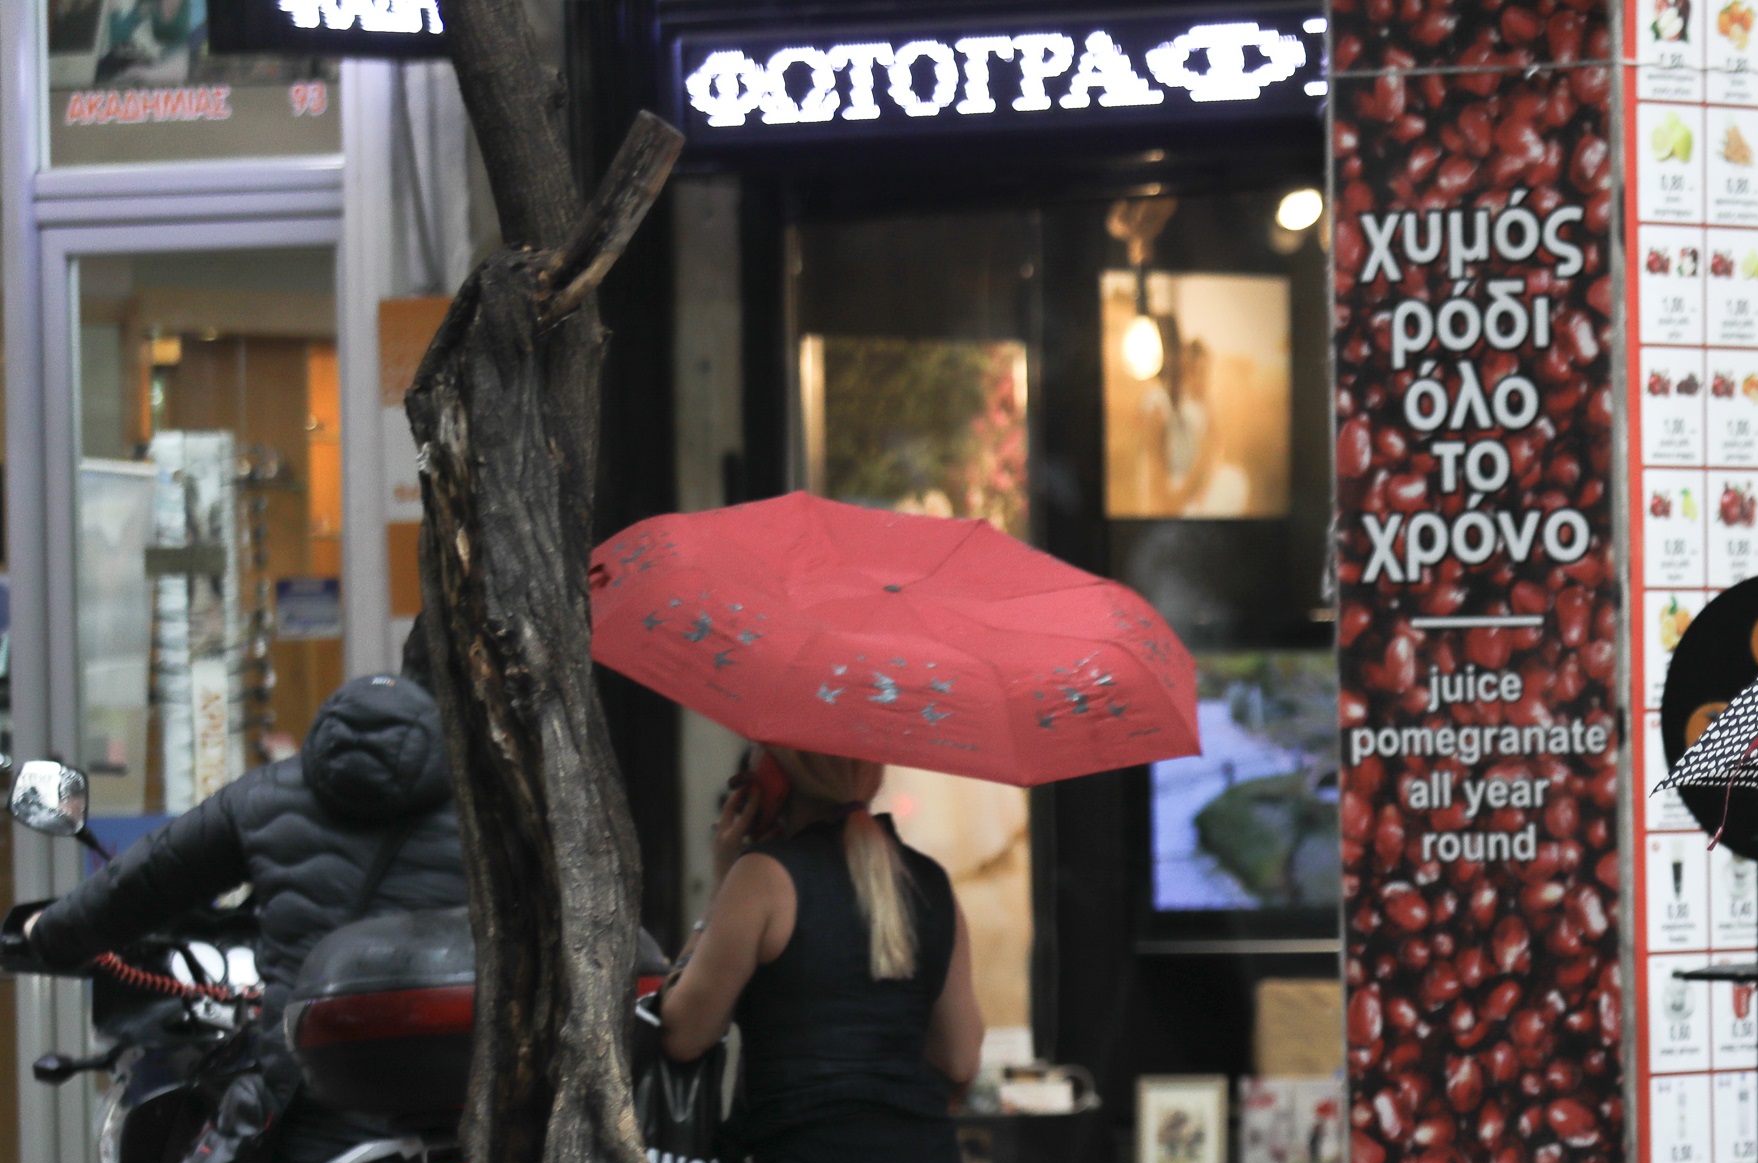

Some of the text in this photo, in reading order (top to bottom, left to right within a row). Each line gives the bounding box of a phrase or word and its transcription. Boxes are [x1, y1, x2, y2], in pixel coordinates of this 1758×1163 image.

[686, 17, 1328, 127] ΦΩΤΟΓΡΑΦ
[65, 80, 327, 126] ΑΚΑΔΗΜΙΑΣ 93
[1360, 188, 1584, 283] χυμός
[1391, 277, 1550, 370] ρόδι
[1404, 361, 1539, 431] όλο
[1432, 440, 1510, 493] το
[1361, 493, 1590, 584] χρόνο
[1427, 664, 1524, 712] juice
[1350, 722, 1607, 765] pomegranate
[1409, 771, 1551, 818] all year
[1421, 823, 1538, 862] round
